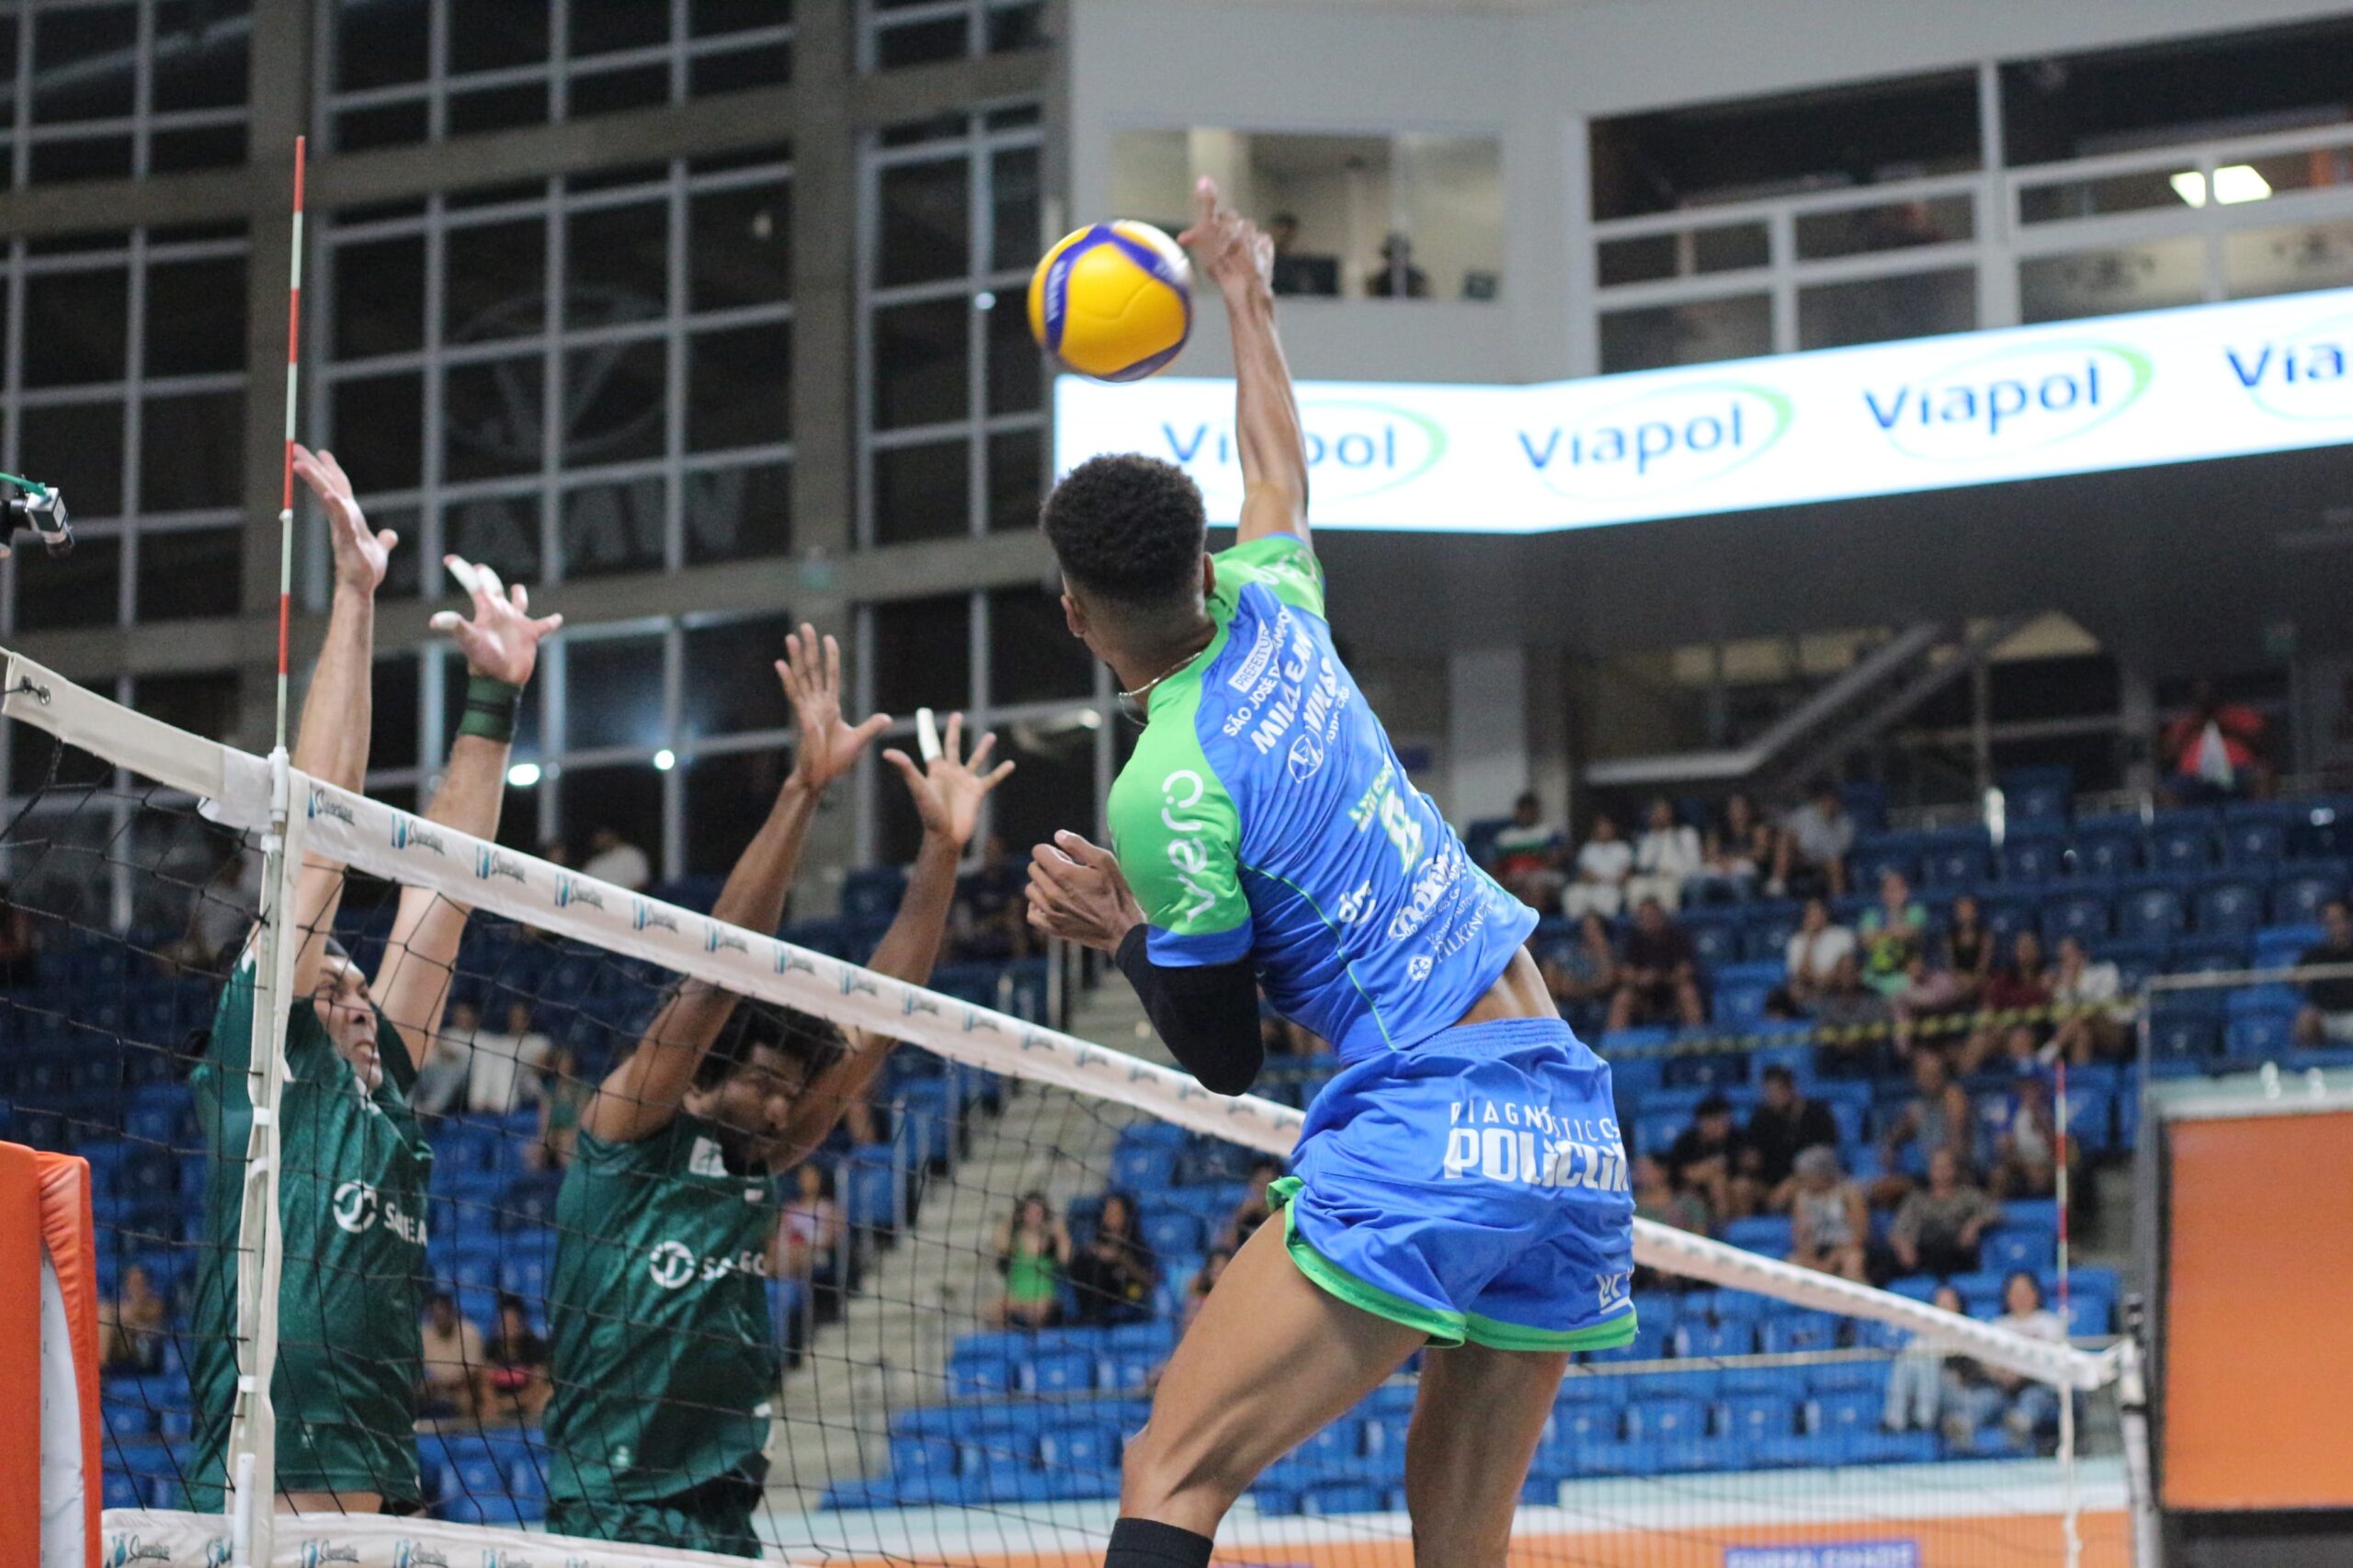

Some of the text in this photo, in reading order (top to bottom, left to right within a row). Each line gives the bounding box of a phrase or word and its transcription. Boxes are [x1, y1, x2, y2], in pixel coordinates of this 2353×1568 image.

[1865, 358, 2100, 436] Viapol
[1162, 422, 1395, 470] Viol
[1518, 400, 1744, 476] Viapol
[1222, 706, 1252, 737] SÃO
[1248, 675, 1278, 710] JOSÉ
